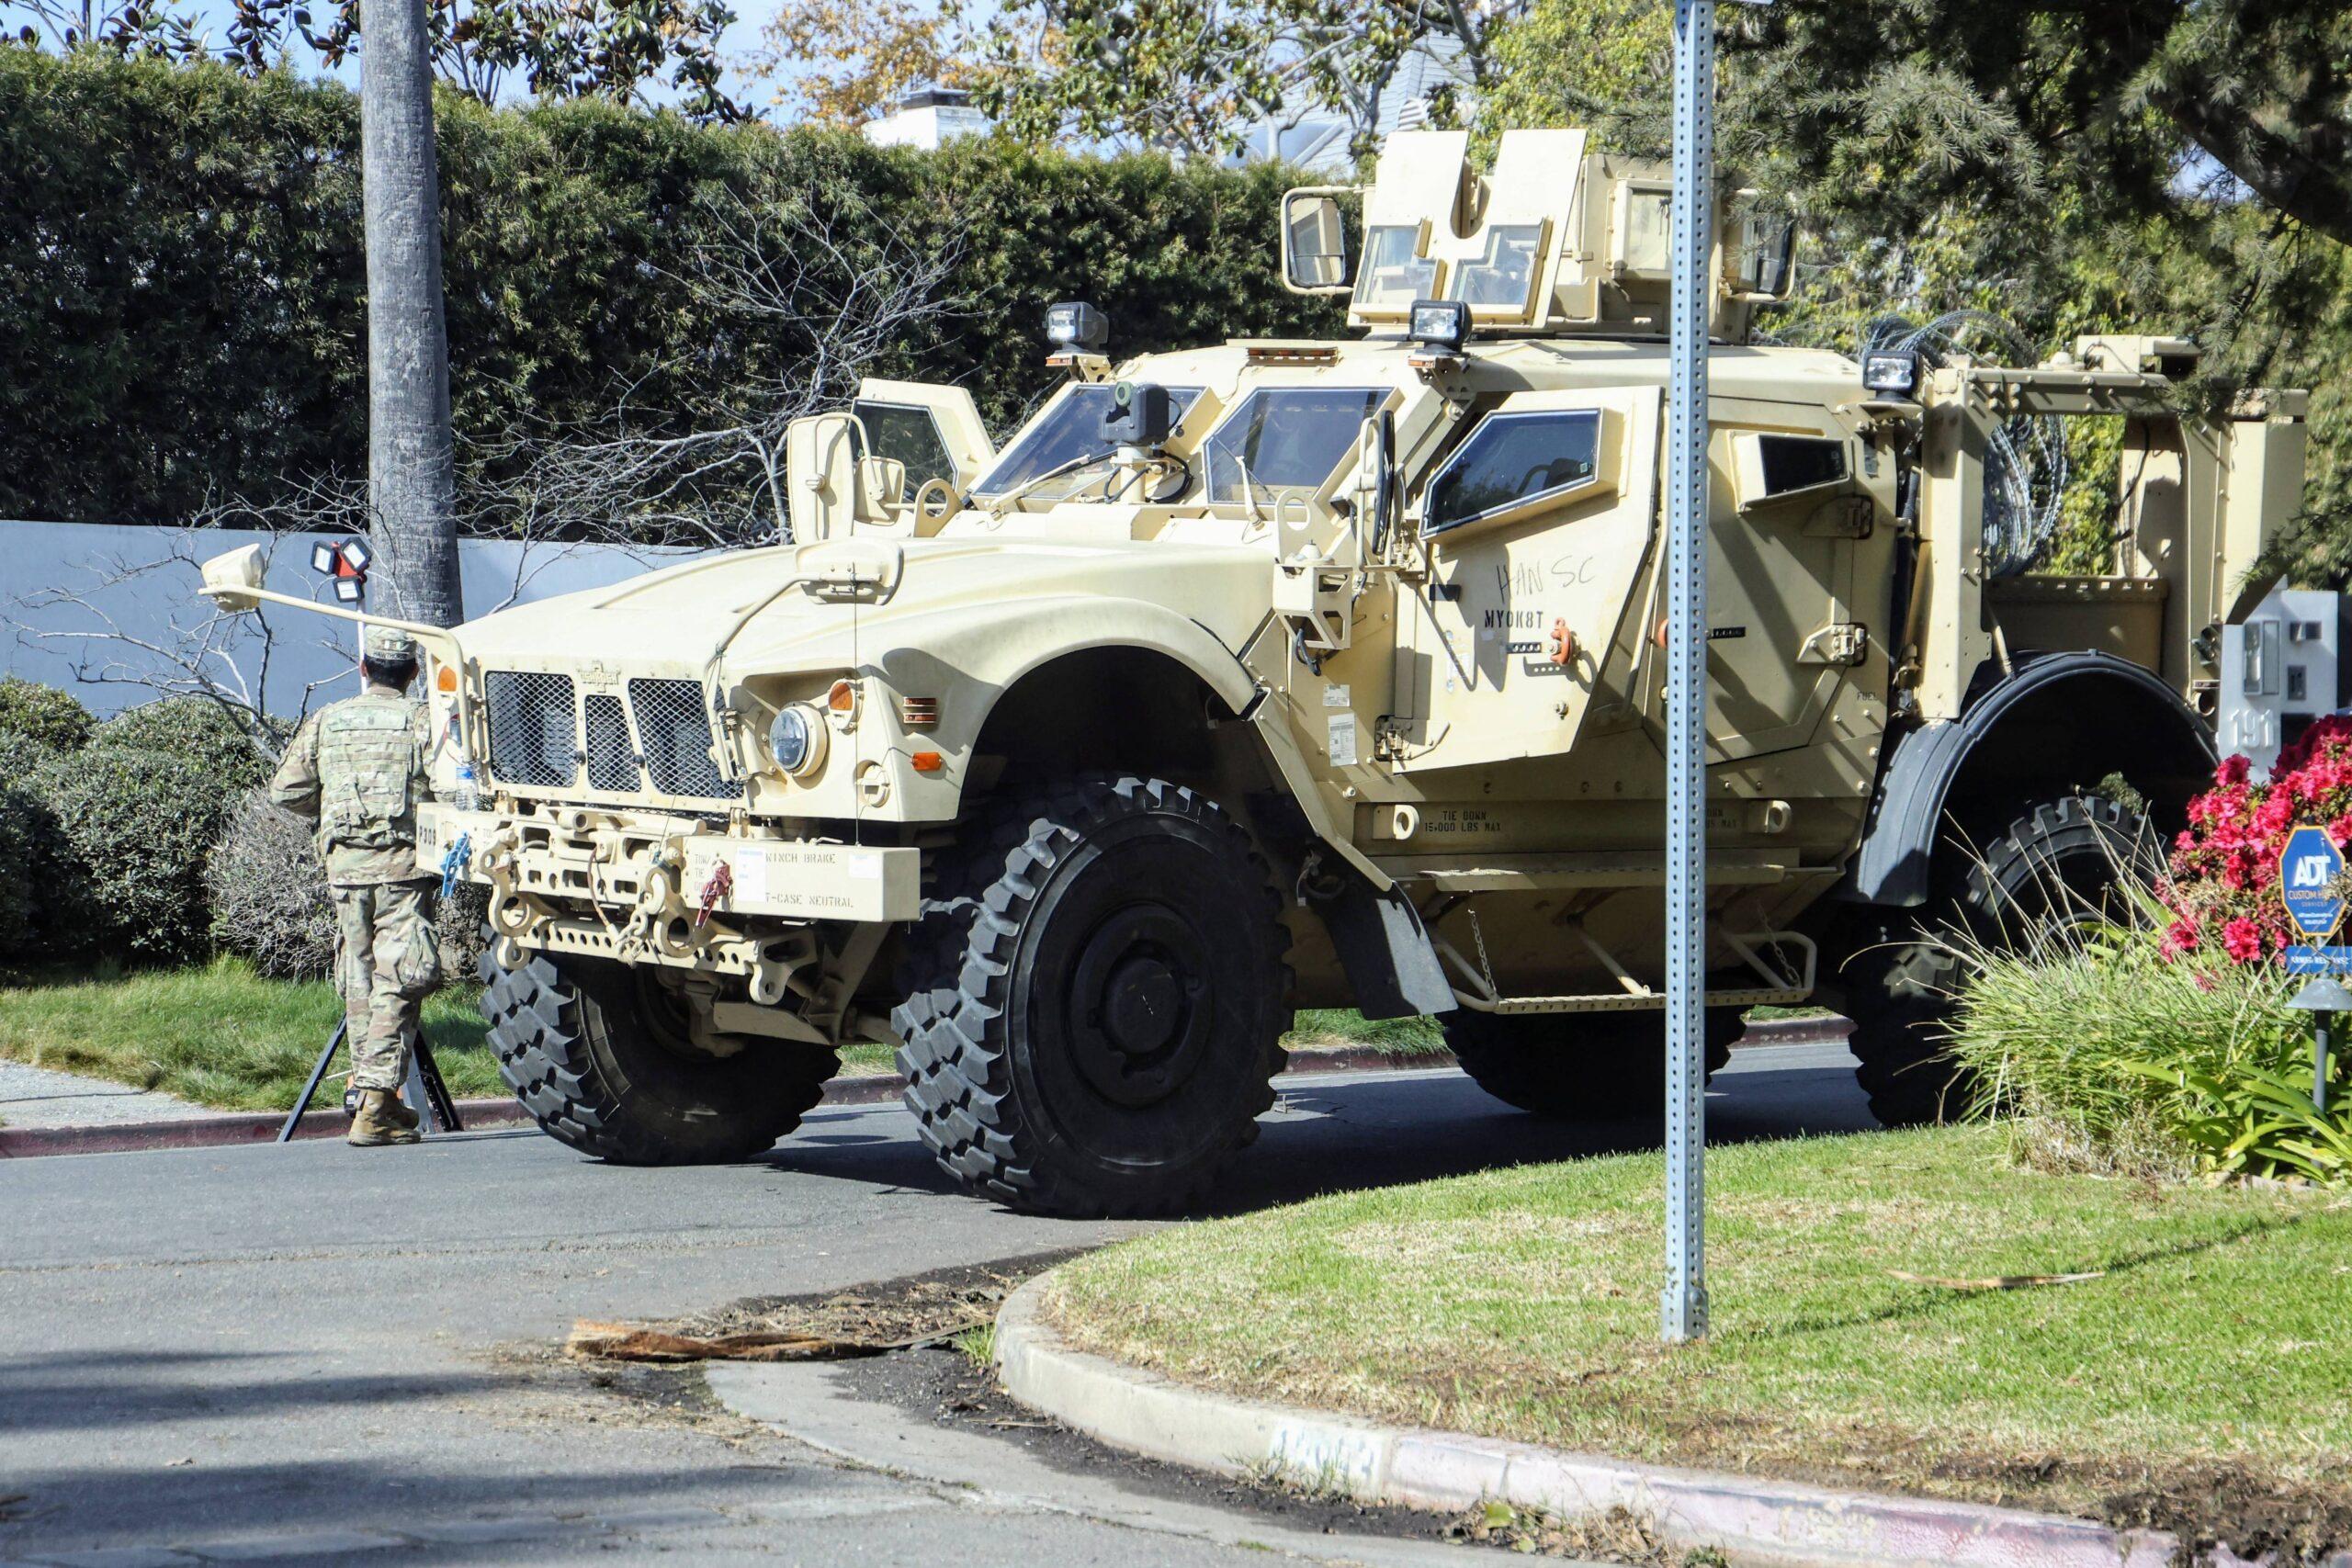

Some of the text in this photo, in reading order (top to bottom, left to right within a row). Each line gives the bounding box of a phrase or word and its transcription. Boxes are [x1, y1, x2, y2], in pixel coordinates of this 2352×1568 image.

[1496, 555, 1596, 604] HAN SC
[1857, 692, 1877, 701] FUEL
[2230, 708, 2274, 748] 191
[1442, 810, 1487, 820] TIE DOWN
[1462, 822, 1478, 832] LBS
[1485, 822, 1501, 832] MAX
[764, 852, 798, 864] WINCH
[804, 852, 836, 864] BRAKE
[2293, 855, 2332, 886] ADT
[765, 892, 854, 908] T-CASE NEUTRAL
[2288, 890, 2316, 900] CUSTOM
[2314, 955, 2349, 965] RESNSE
